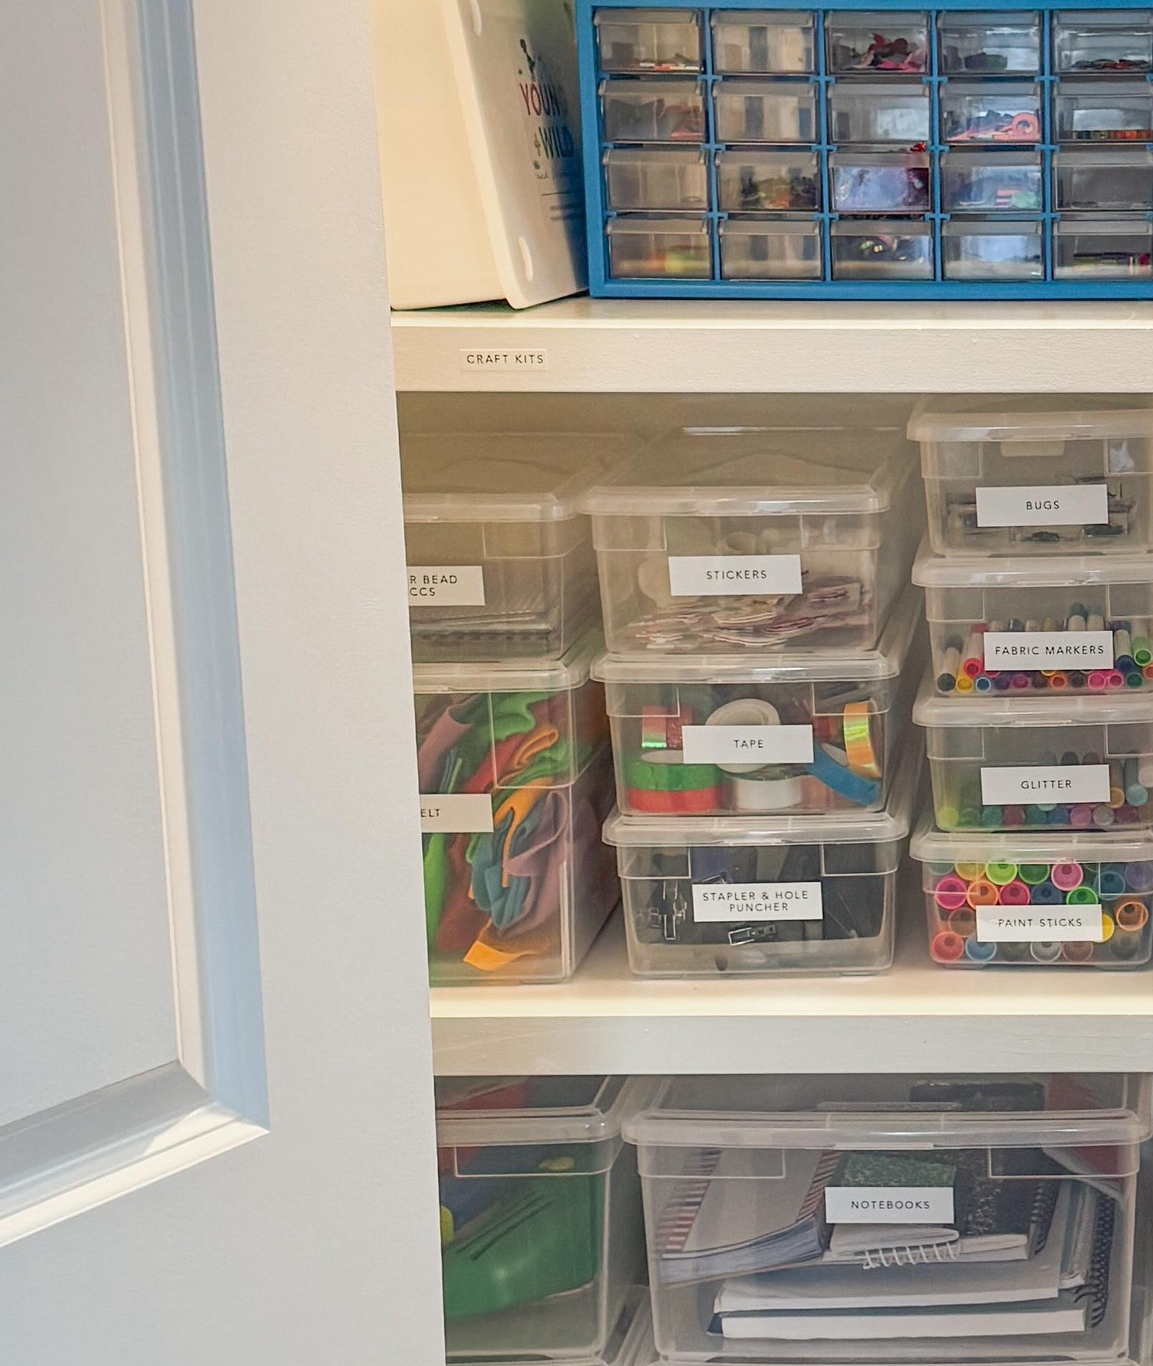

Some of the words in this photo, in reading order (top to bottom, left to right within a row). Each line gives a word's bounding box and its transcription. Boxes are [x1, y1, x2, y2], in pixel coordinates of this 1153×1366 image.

[466, 354, 510, 365] CRAFT
[515, 354, 544, 365] KITS
[1026, 500, 1060, 511] BUGS
[706, 569, 768, 580] STICKERS
[995, 645, 1039, 656] FABRIC
[1045, 645, 1104, 655] MARKERS
[733, 738, 765, 749] TAPE
[1020, 779, 1073, 790] GLITTER
[702, 892, 754, 903] STAPLER
[761, 891, 771, 901] &
[775, 889, 809, 900] HOLE
[729, 901, 789, 913] PUNCHER
[997, 918, 1033, 928] PAINT
[1039, 917, 1083, 927] STICKS
[851, 1200, 931, 1210] NOTEBOOKS
